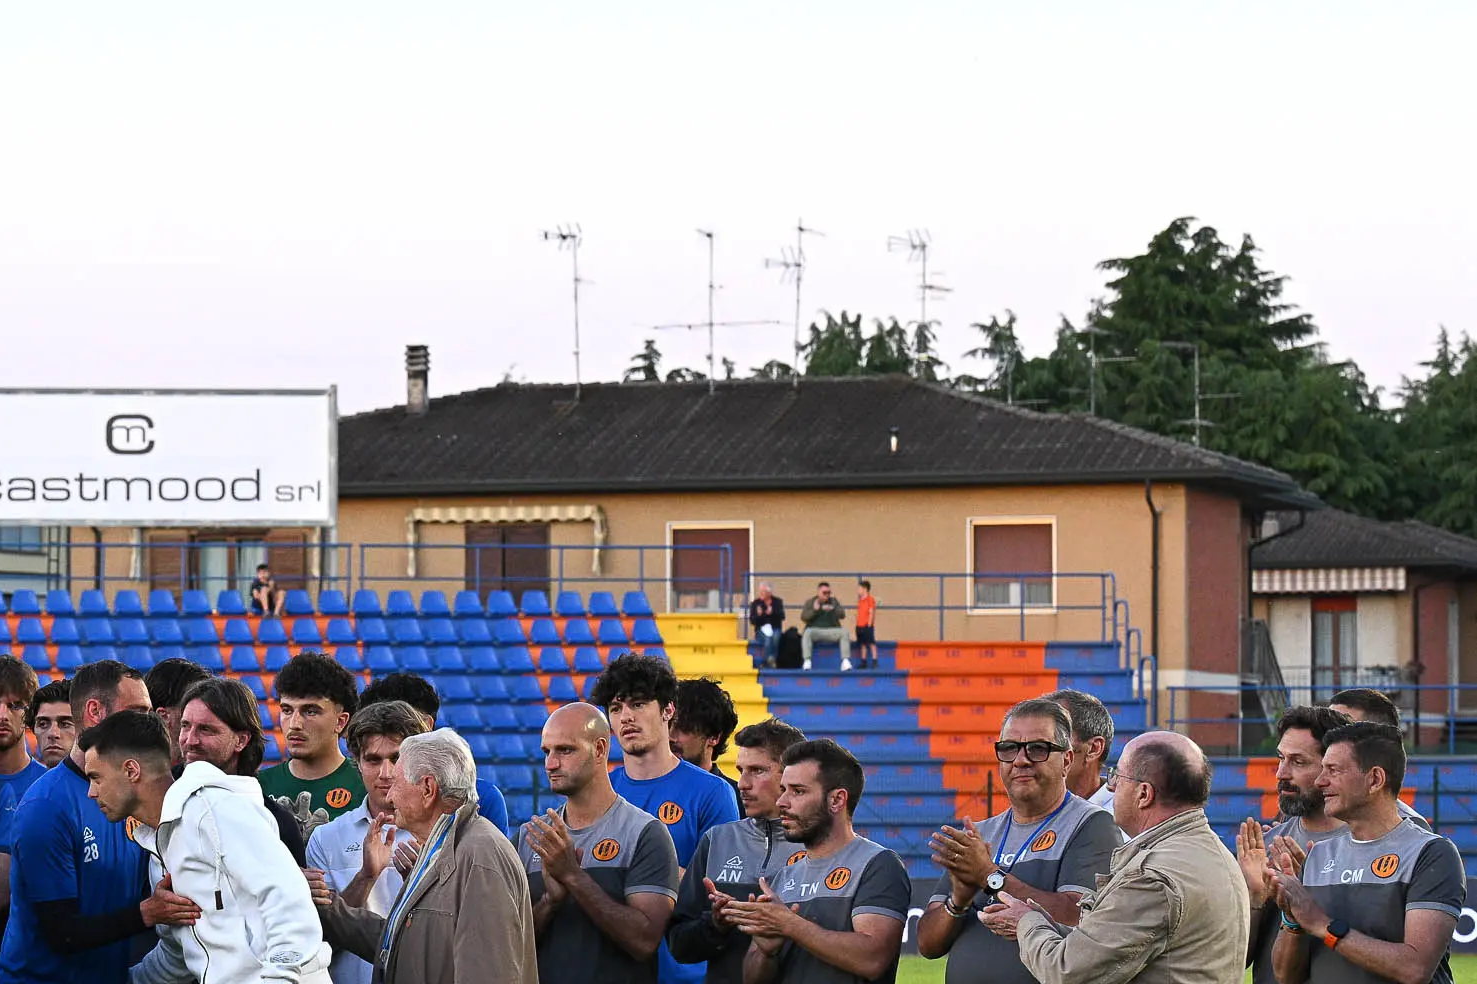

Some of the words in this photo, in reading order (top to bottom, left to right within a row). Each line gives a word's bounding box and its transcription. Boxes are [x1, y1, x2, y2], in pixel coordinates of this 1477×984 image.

[275, 479, 322, 502] srl
[84, 843, 99, 862] 28
[716, 869, 743, 882] AN
[1340, 869, 1364, 883] CM
[800, 882, 820, 896] TN
